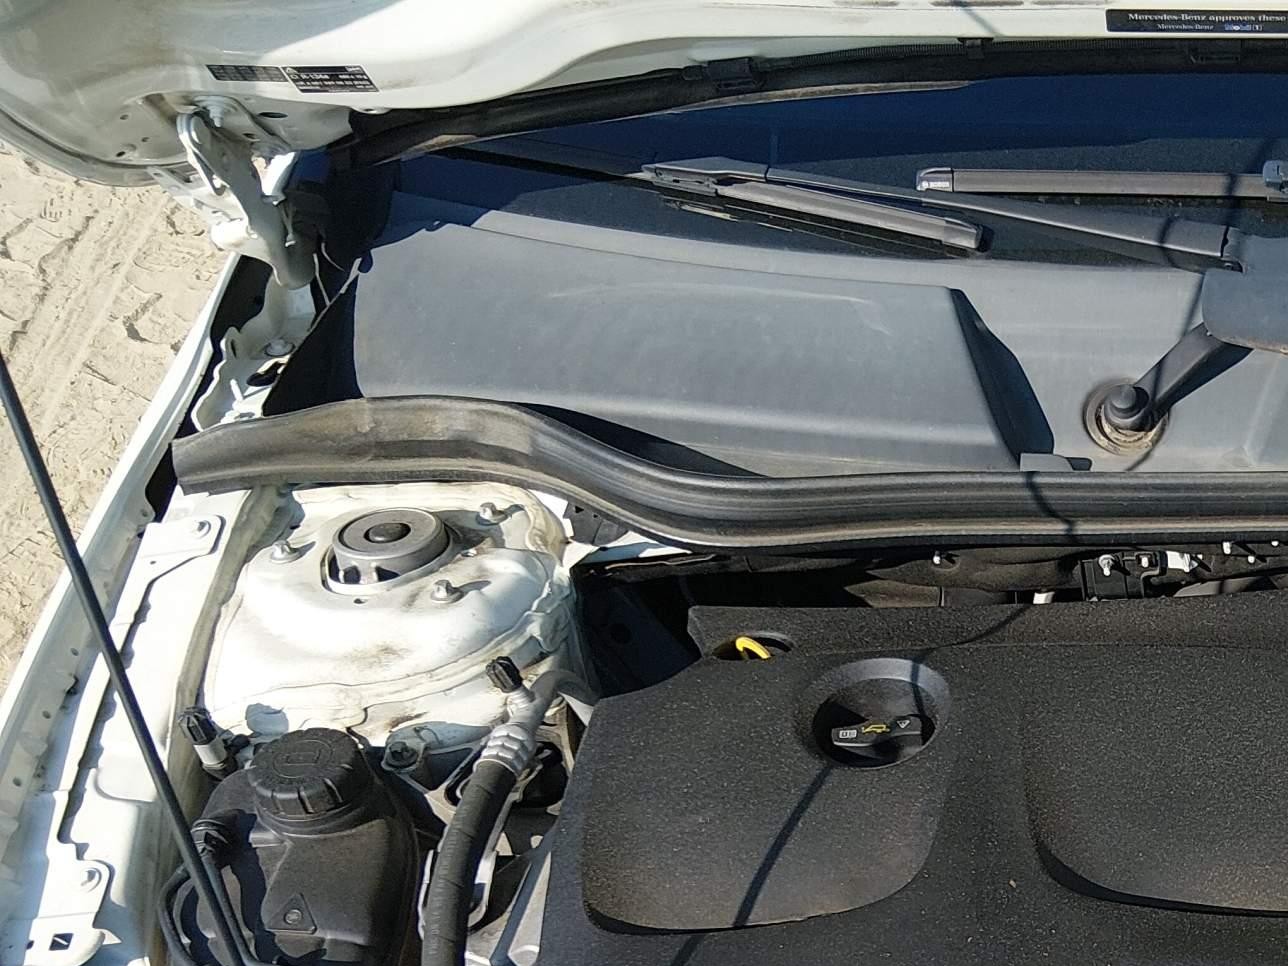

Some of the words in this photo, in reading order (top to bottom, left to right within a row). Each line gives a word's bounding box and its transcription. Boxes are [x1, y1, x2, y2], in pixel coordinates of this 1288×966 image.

[1128, 13, 1207, 21] Mercedes-Benz
[1208, 15, 1256, 23] approves
[1258, 14, 1287, 22] these
